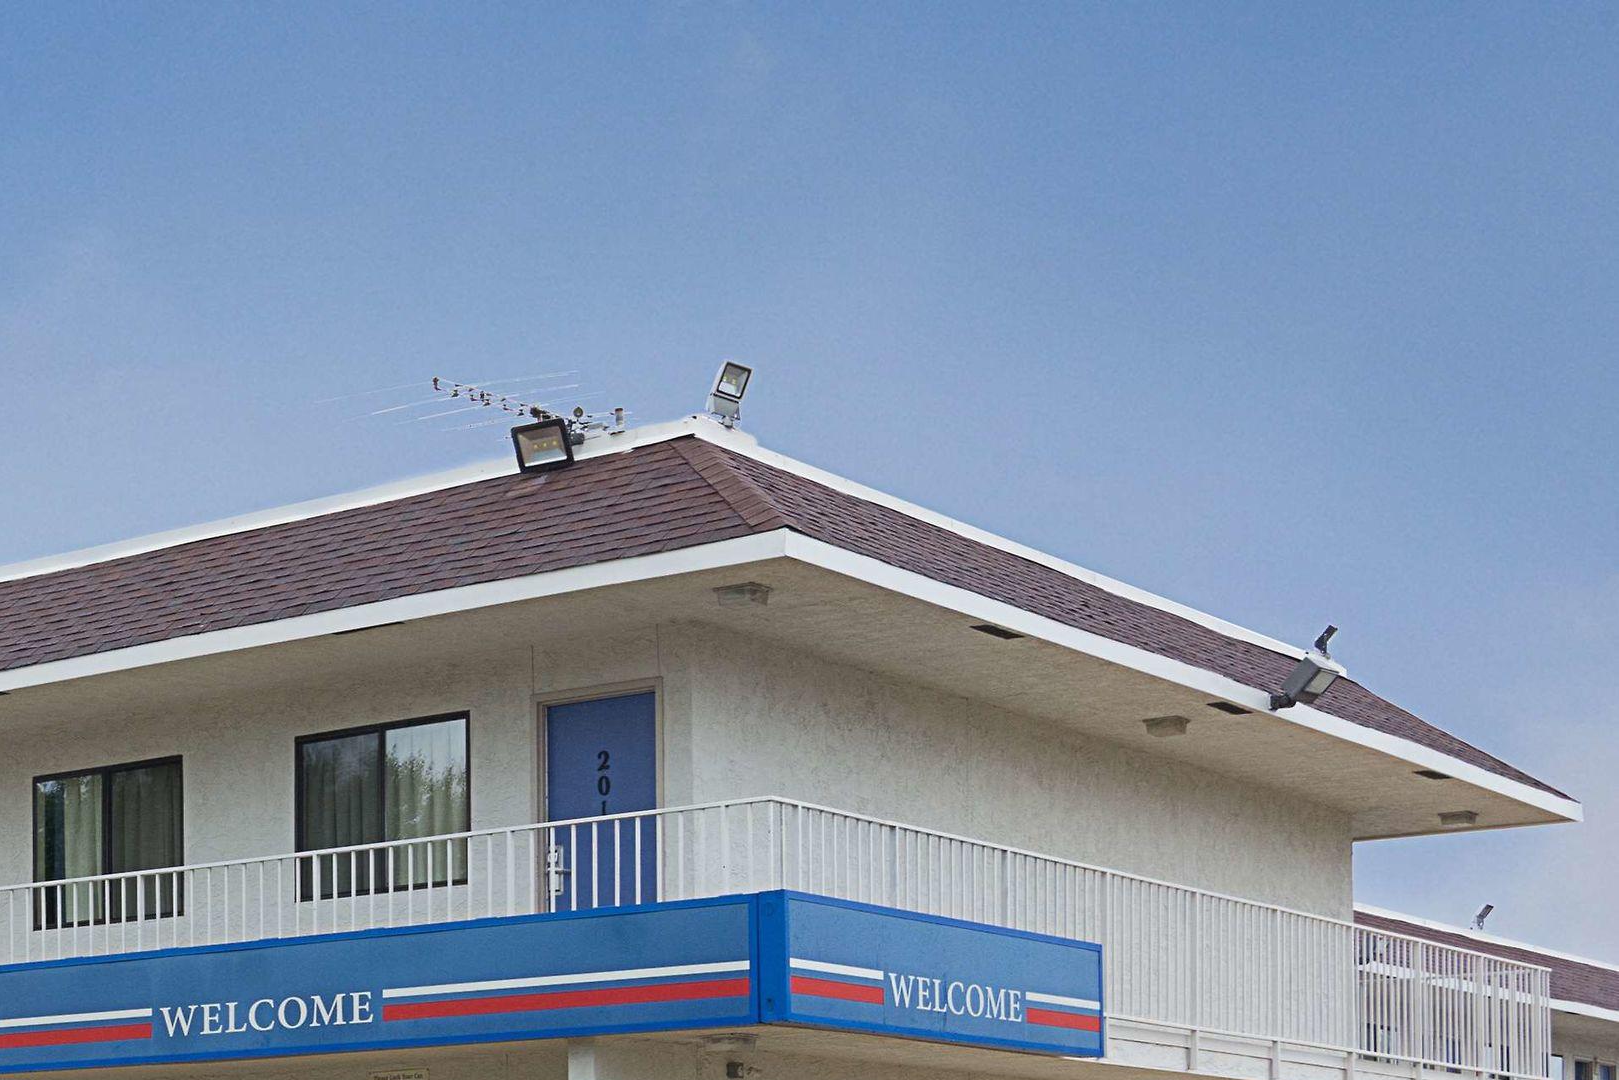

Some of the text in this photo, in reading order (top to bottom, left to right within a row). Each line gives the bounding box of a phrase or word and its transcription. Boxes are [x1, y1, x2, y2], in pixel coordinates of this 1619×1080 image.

[597, 750, 611, 815] 201
[159, 991, 374, 1038] WELCOME
[888, 972, 1023, 1023] WELCOME
